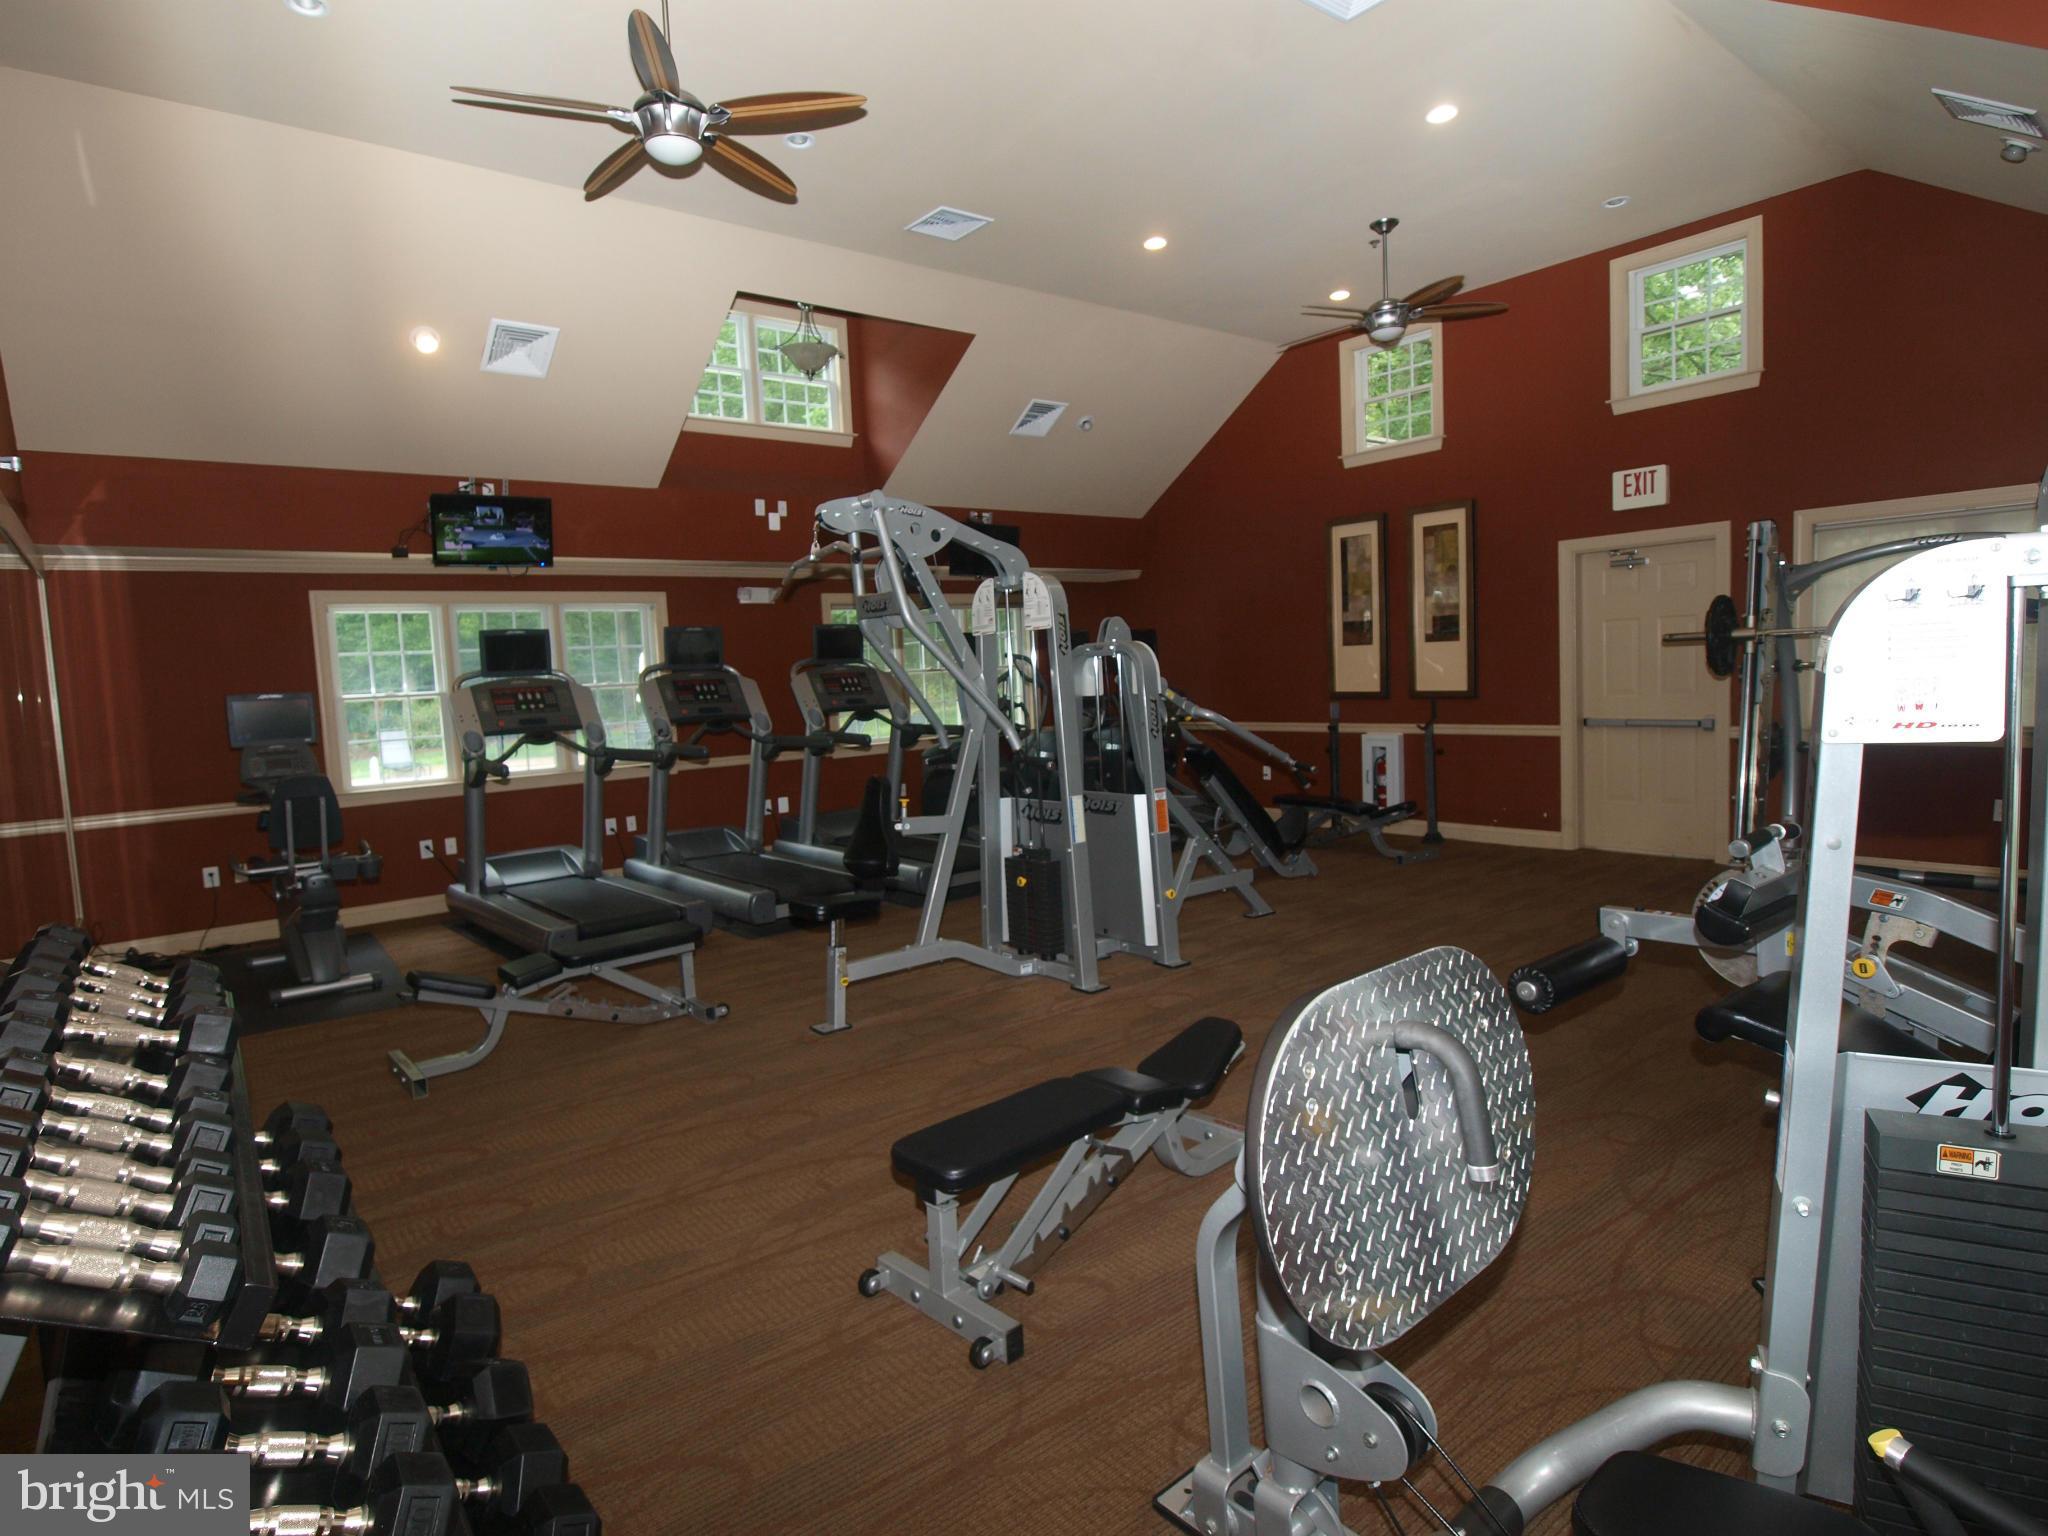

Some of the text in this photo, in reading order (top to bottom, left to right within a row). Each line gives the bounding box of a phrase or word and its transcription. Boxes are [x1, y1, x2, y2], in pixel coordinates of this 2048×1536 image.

[1624, 470, 1657, 497] EXIT
[899, 505, 926, 517] HOIST
[1949, 1150, 1972, 1161] WARNING
